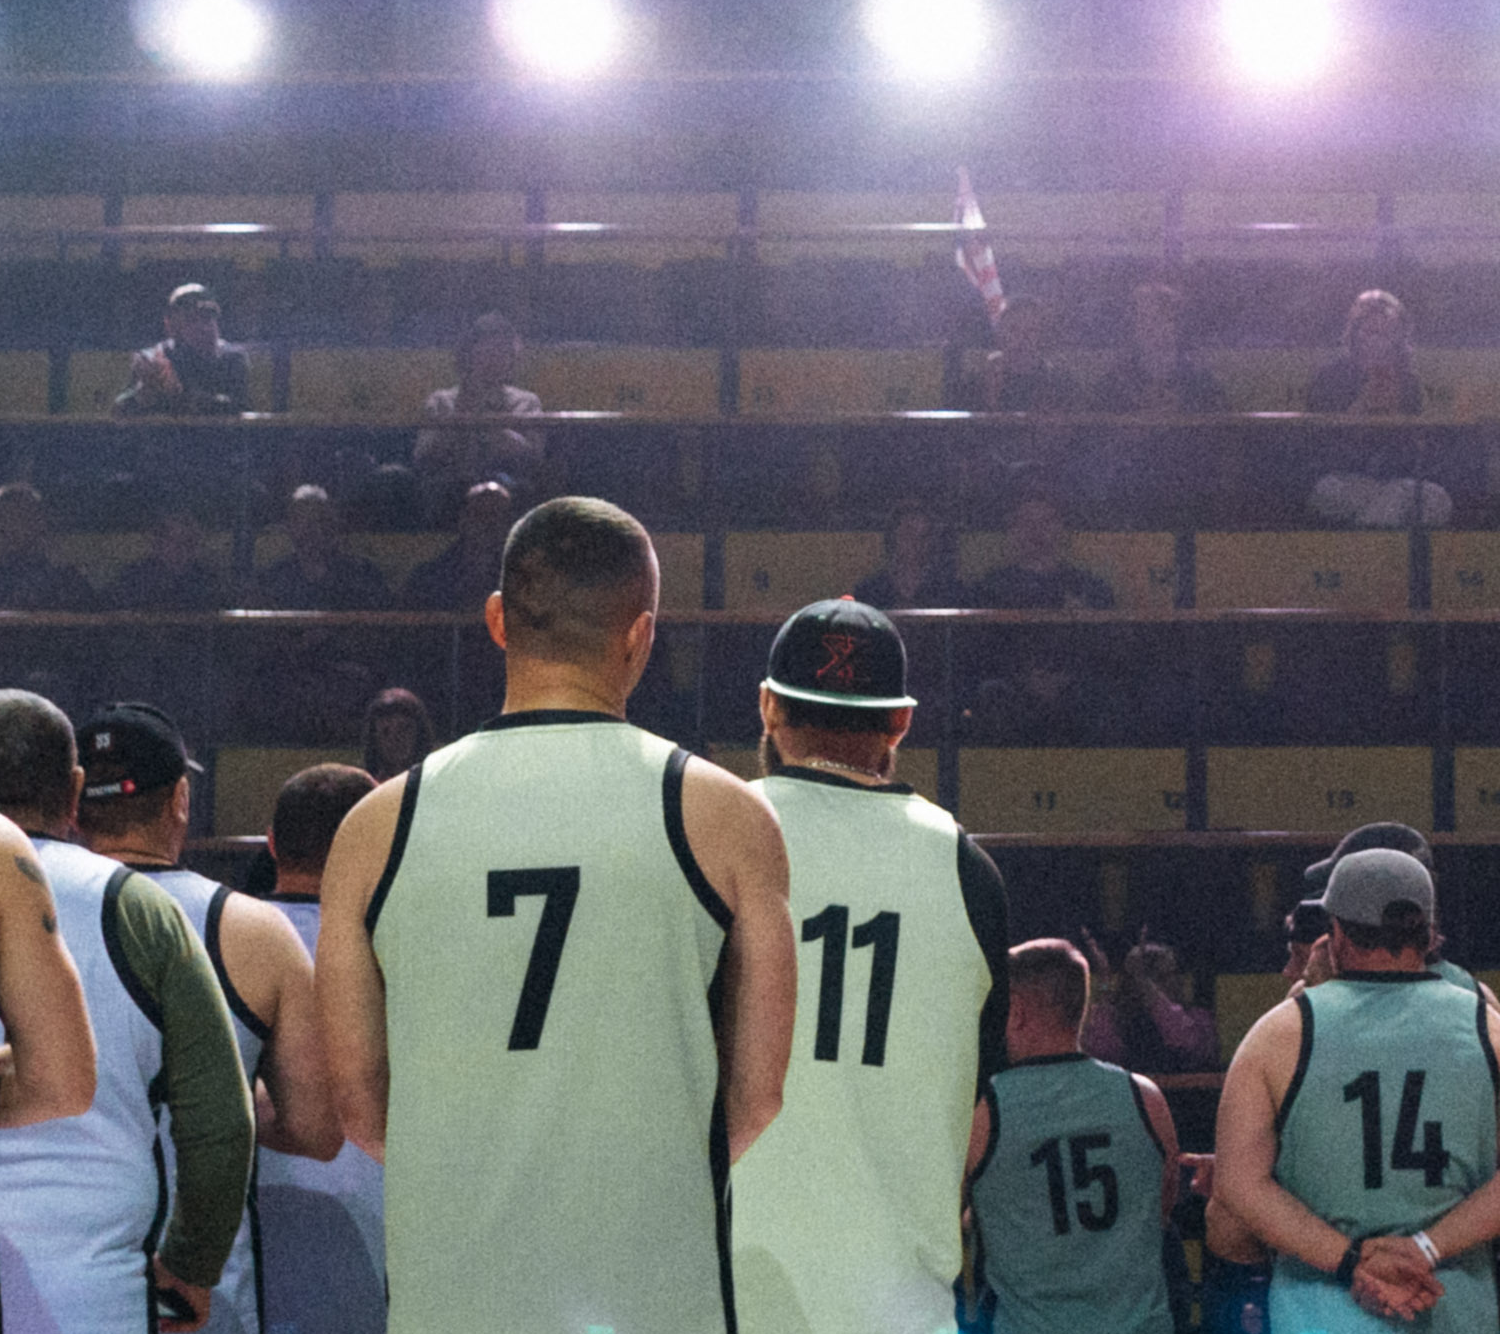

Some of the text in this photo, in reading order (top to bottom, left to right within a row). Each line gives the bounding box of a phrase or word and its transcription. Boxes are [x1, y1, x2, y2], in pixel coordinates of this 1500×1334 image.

[486, 867, 582, 1052] 7
[801, 904, 901, 1068] 11
[1030, 1133, 1121, 1236] 15
[1342, 1070, 1450, 1192] 14
